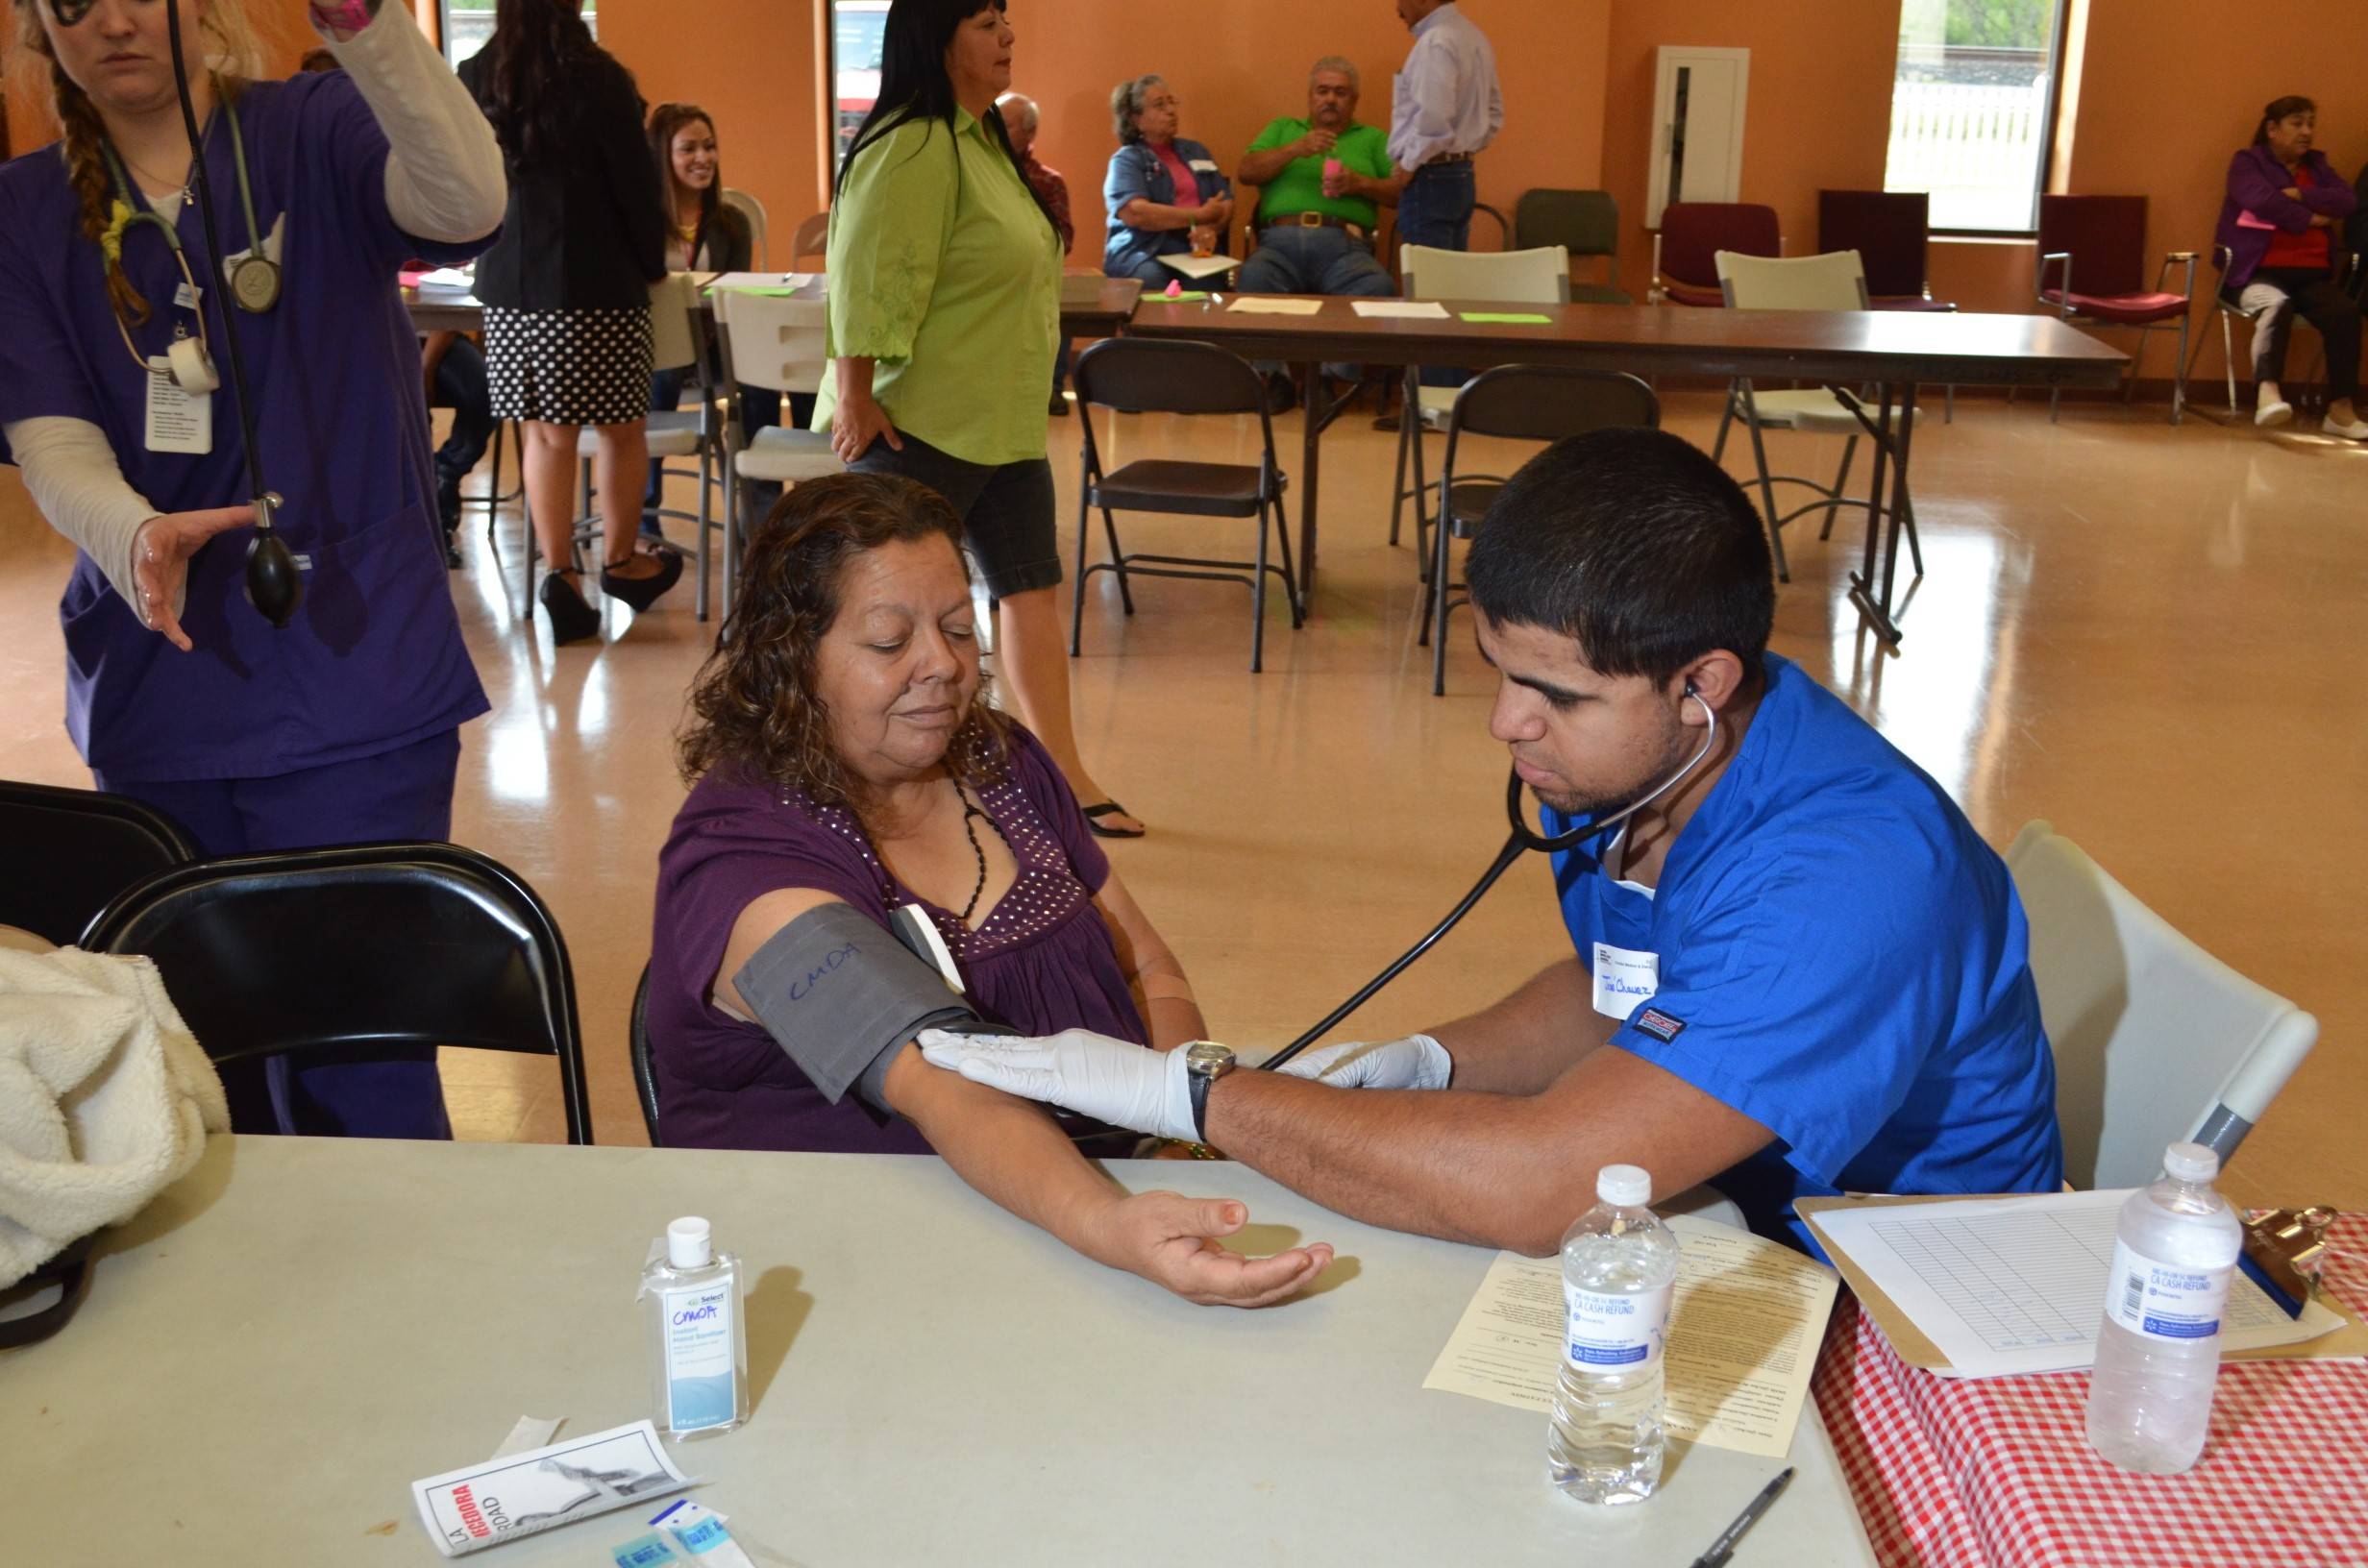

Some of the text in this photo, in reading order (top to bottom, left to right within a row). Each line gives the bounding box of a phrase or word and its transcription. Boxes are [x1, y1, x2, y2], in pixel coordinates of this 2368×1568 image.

[2161, 1278, 2182, 1289] CASH
[2183, 1281, 2211, 1291] REFUND
[701, 1293, 724, 1303] Select
[1584, 1302, 1604, 1314] CASH
[1605, 1305, 1635, 1315] REFUND
[449, 1528, 469, 1544] LA
